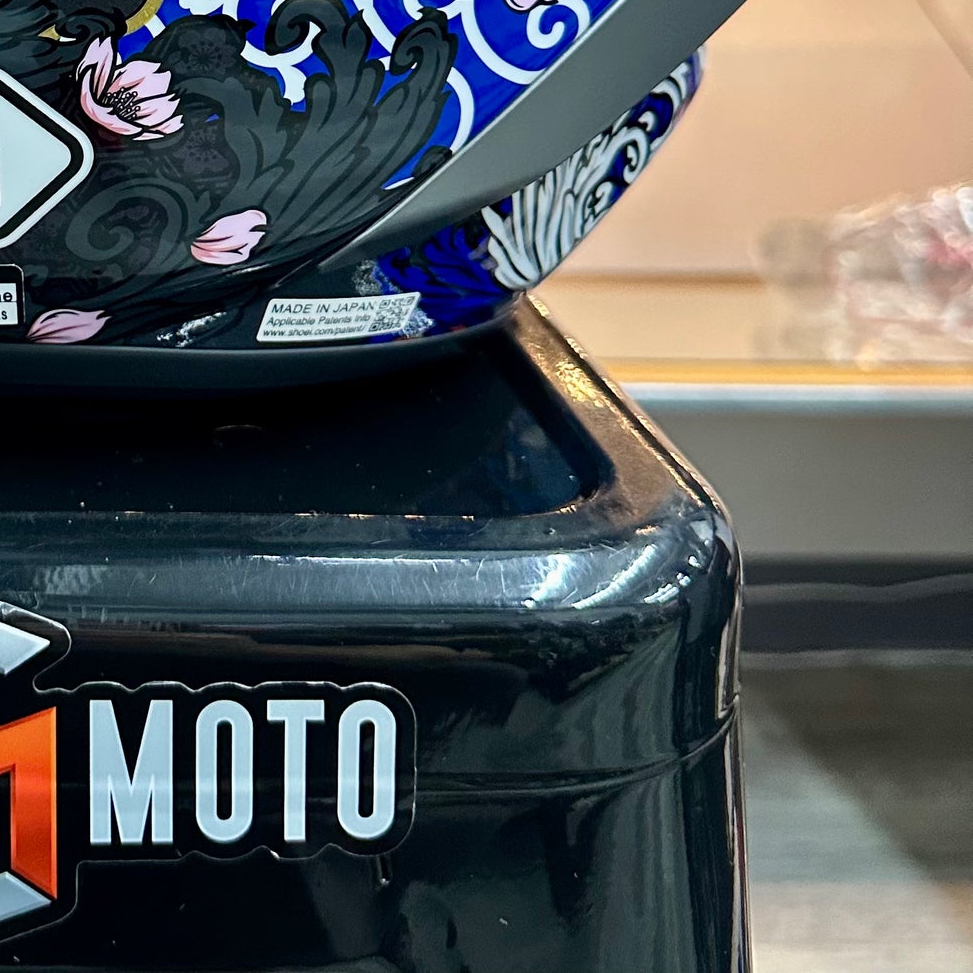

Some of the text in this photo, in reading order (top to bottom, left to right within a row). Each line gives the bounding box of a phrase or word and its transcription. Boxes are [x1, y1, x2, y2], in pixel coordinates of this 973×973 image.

[271, 301, 376, 314] MADE IN JAPAN
[266, 316, 315, 326] Applicable
[89, 699, 397, 846] MOTO
